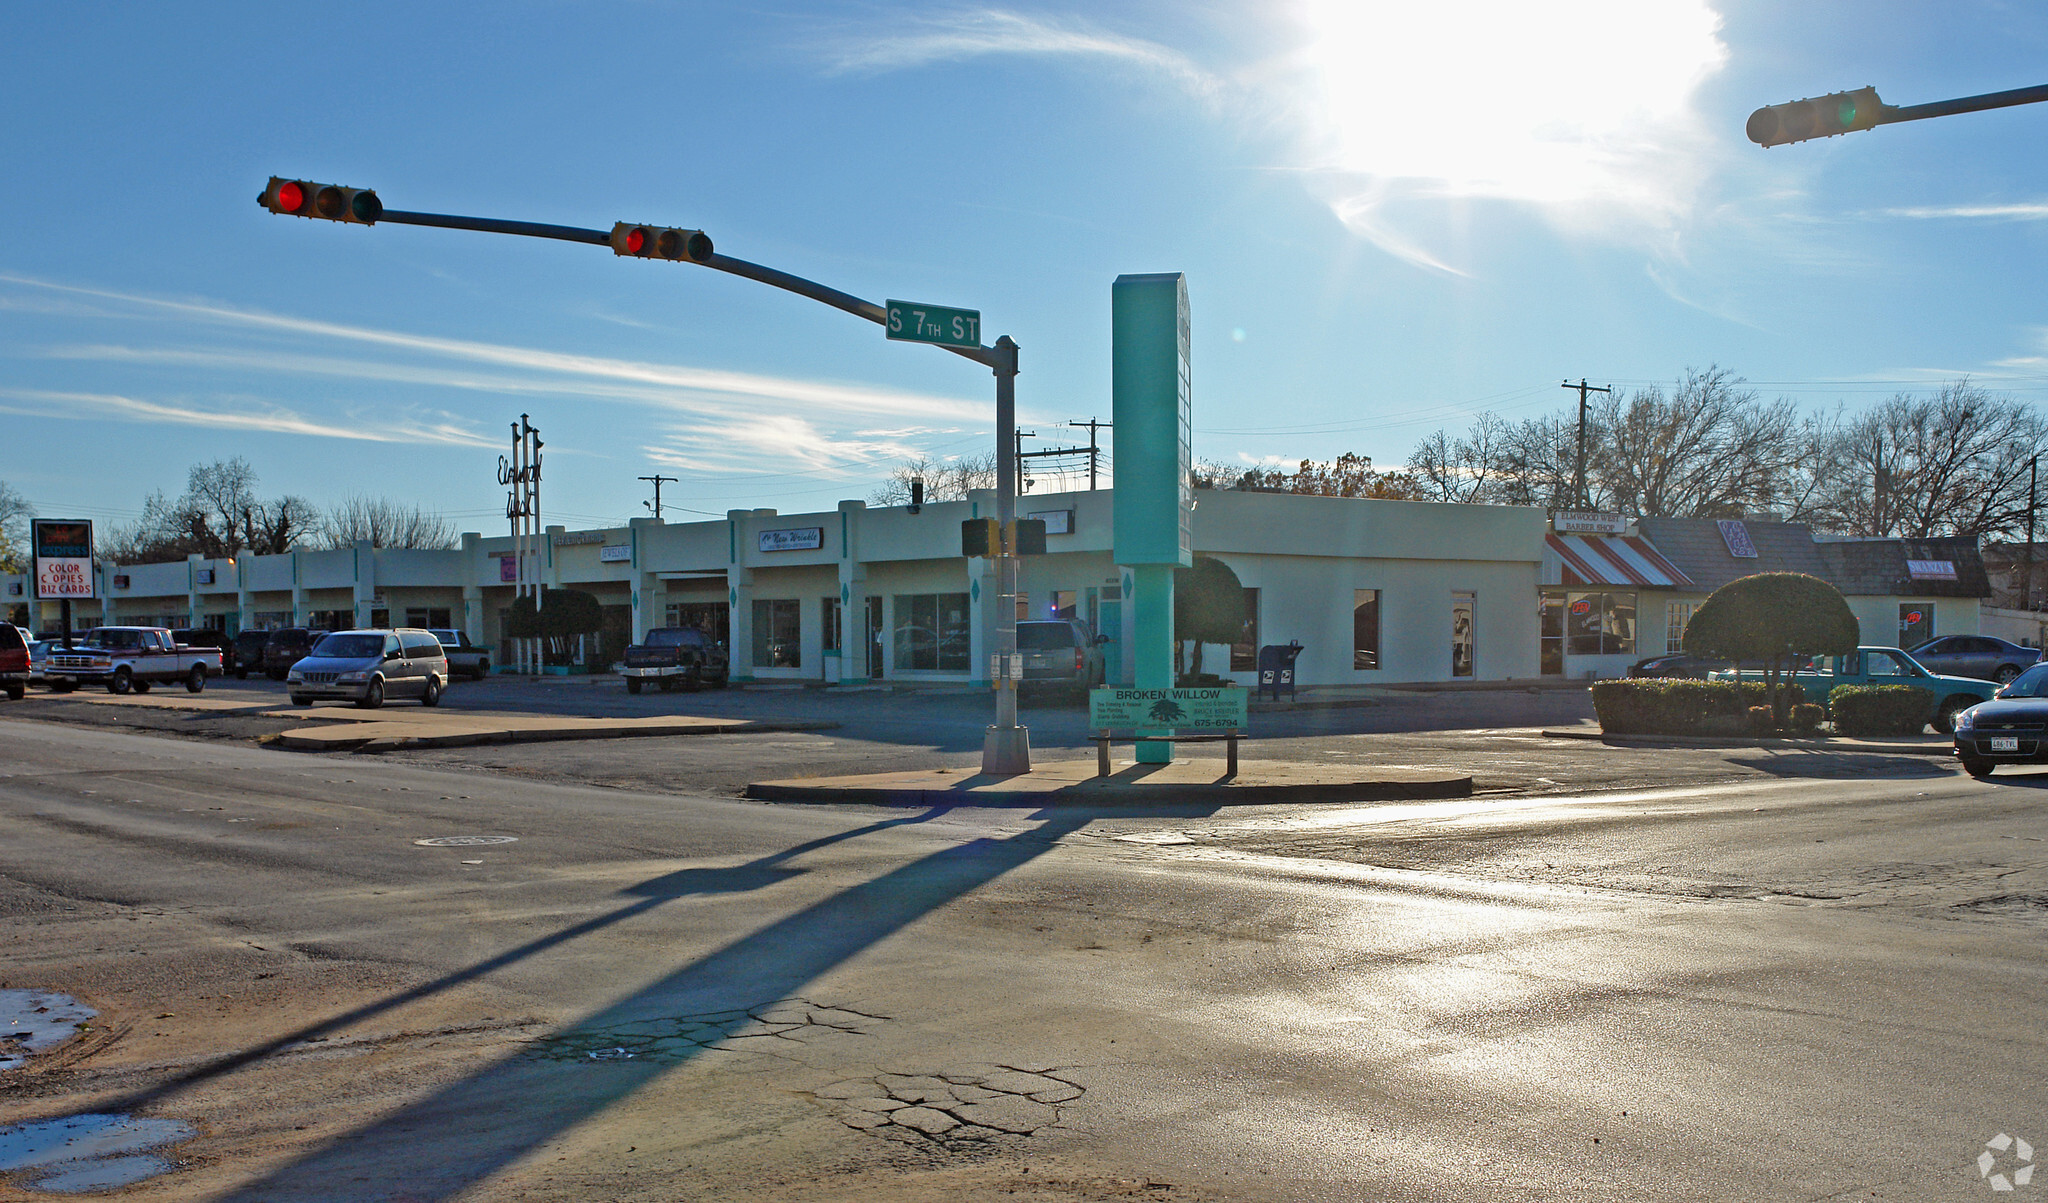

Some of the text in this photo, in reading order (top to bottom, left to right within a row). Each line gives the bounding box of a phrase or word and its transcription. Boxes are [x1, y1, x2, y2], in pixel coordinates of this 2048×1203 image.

[889, 308, 978, 341] S 7TH ST
[1600, 514, 1620, 523] WEST
[1565, 522, 1615, 532] BARBER SHOP
[773, 532, 788, 544] New
[789, 530, 817, 542] Wrinkle
[41, 545, 87, 556] express
[48, 563, 80, 573] COLOR
[41, 584, 91, 594] BIZ CARDS
[1116, 689, 1220, 700] BROKEN WILLOW
[1194, 719, 1238, 727] 675-6794
